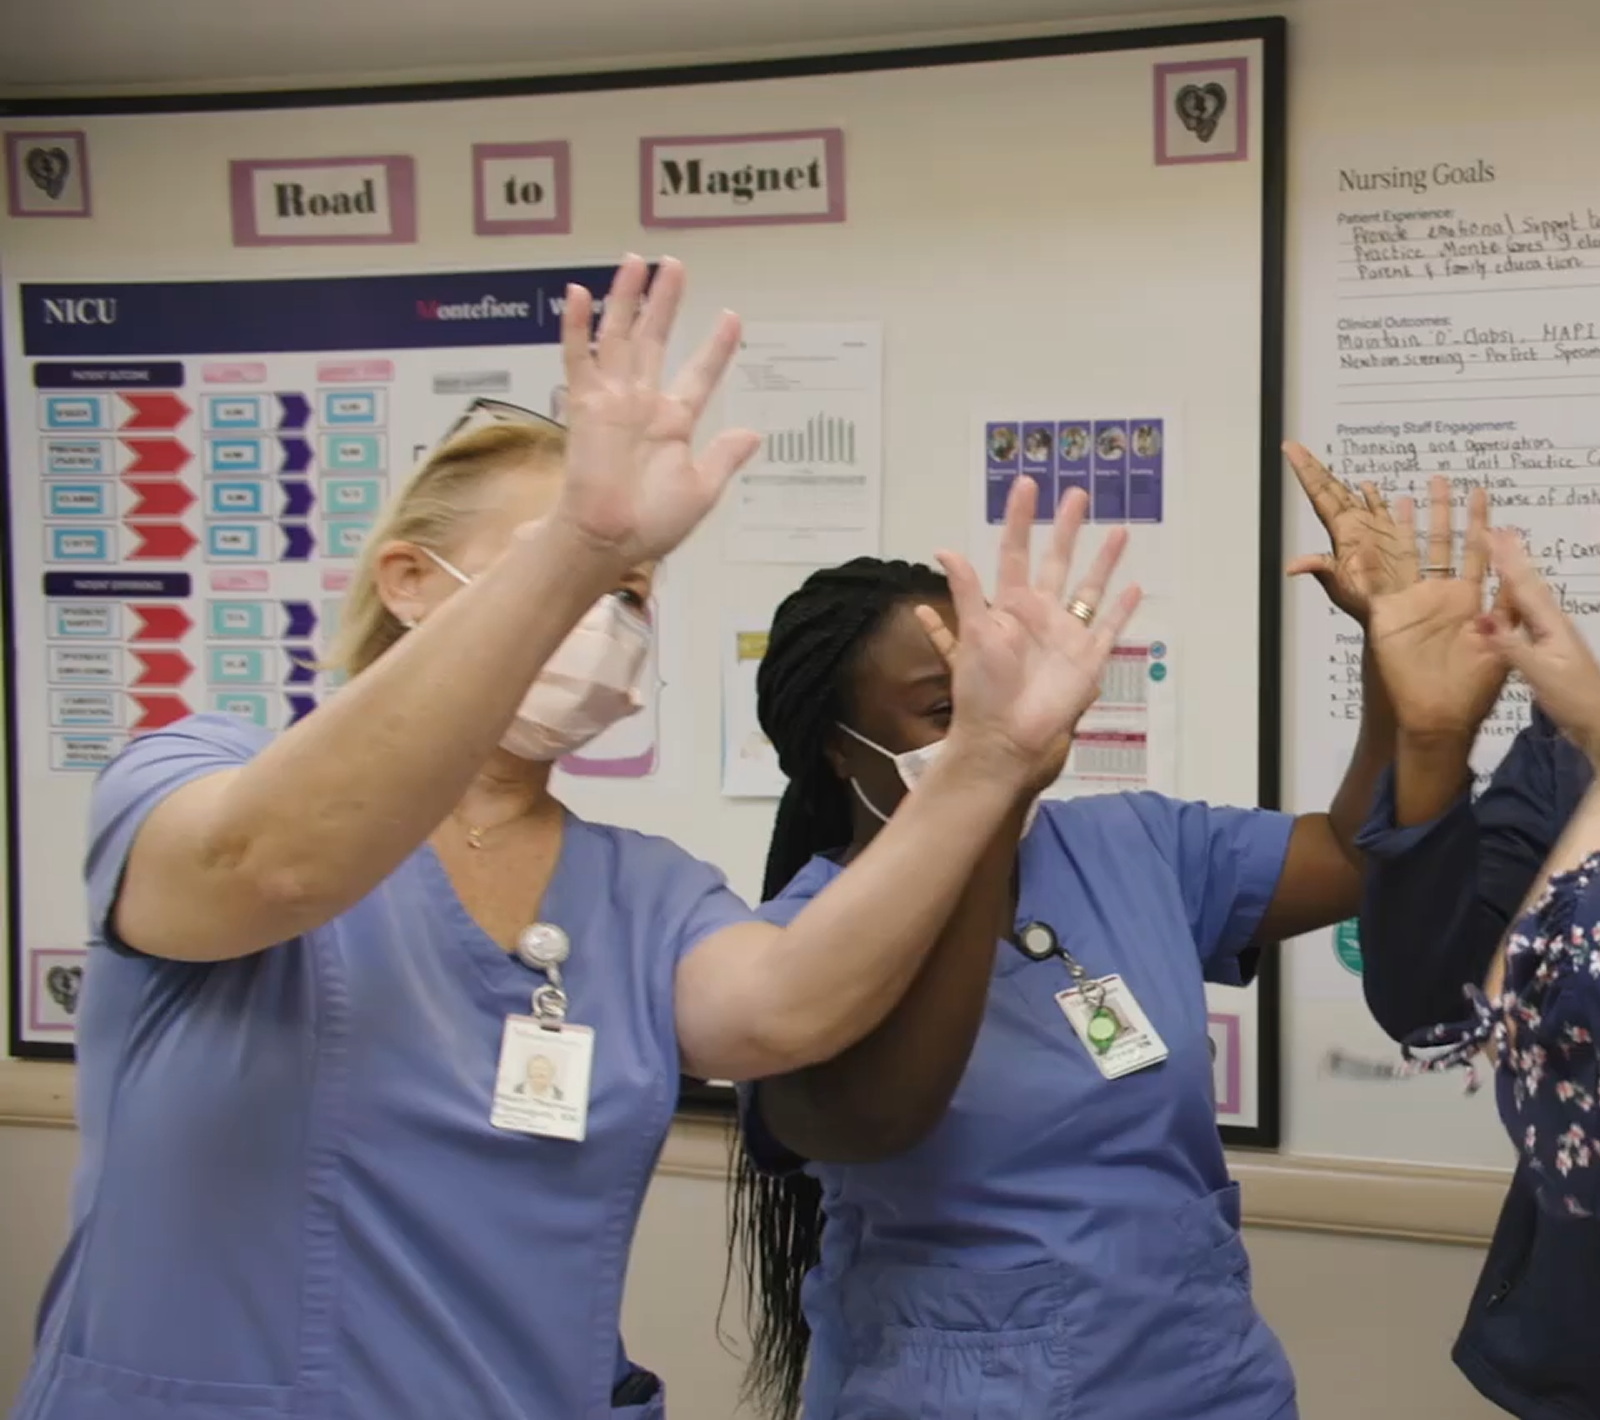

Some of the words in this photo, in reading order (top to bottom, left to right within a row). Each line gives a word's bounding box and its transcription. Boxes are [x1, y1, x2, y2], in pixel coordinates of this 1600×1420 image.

[274, 178, 377, 218] Road
[504, 173, 544, 205] to
[659, 155, 822, 204] Magnet
[1338, 166, 1428, 195] Nursing
[1431, 158, 1497, 187] Goals
[1336, 211, 1381, 226] Patient
[42, 298, 118, 325] NICU
[415, 295, 529, 320] Montefiore
[1336, 421, 1401, 439] Promoting
[1402, 418, 1433, 435] Staff
